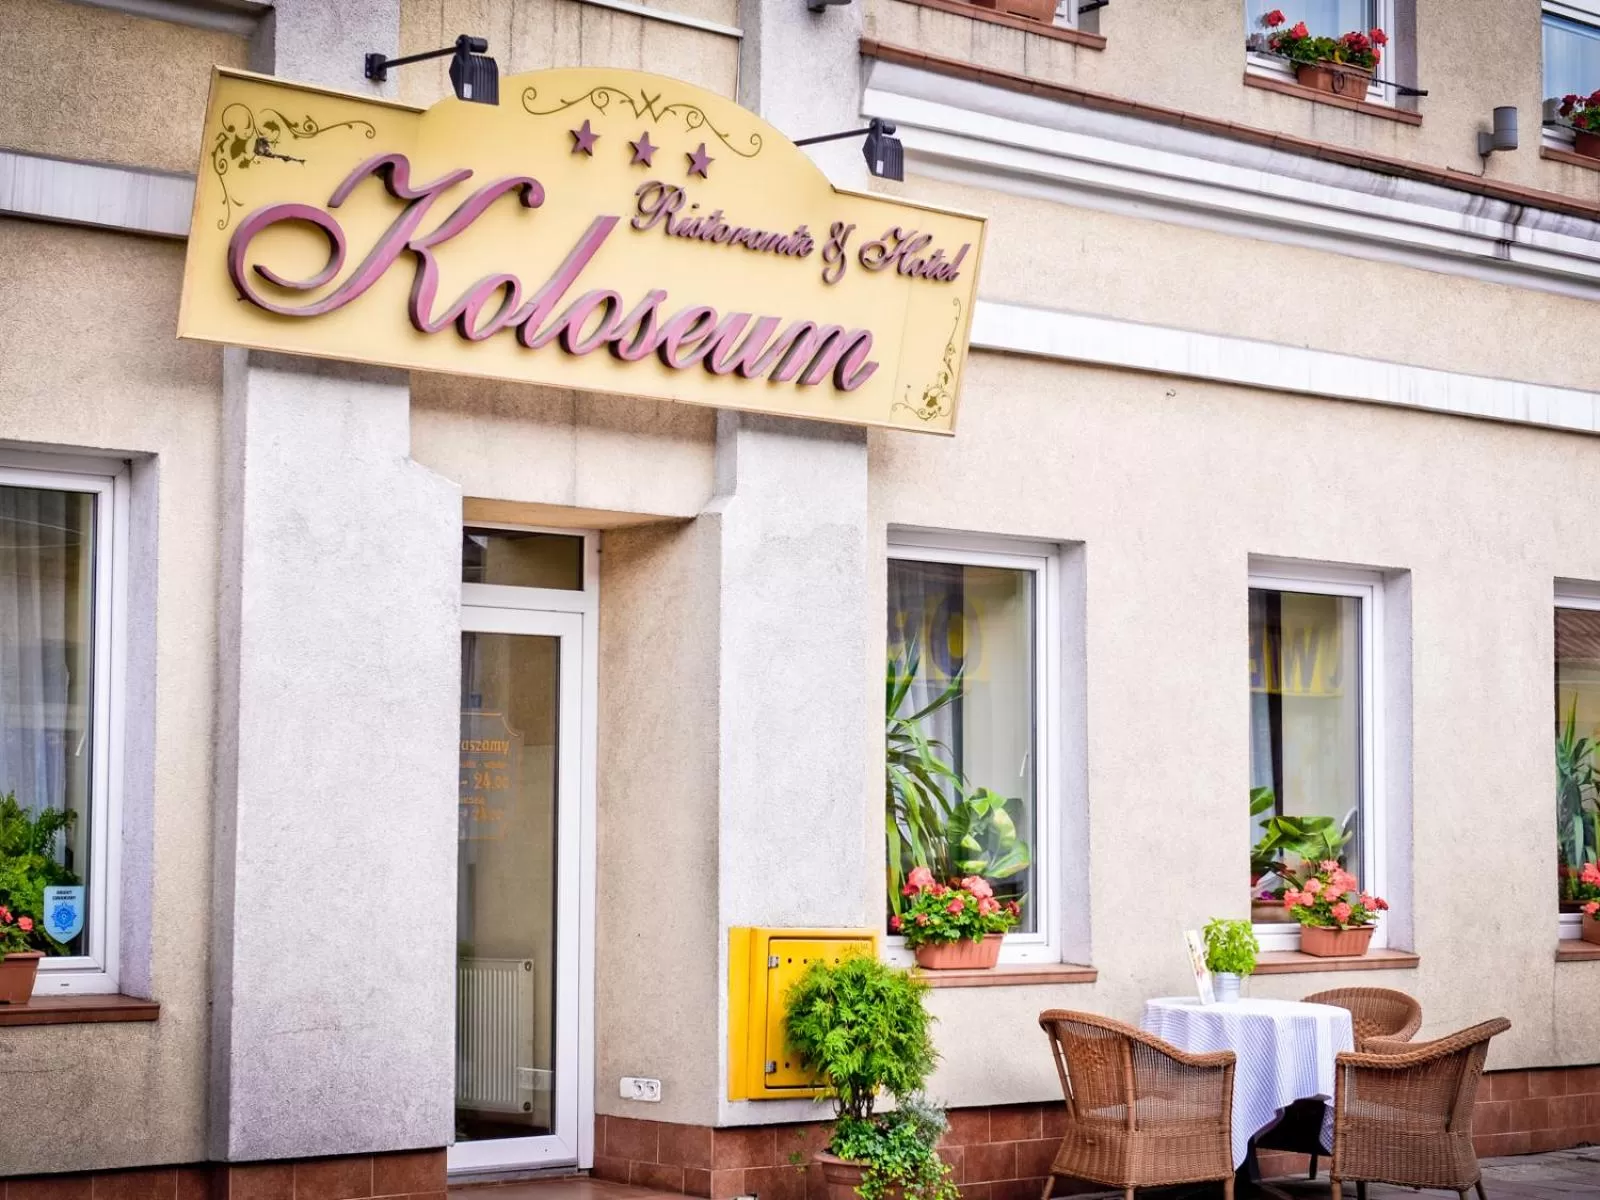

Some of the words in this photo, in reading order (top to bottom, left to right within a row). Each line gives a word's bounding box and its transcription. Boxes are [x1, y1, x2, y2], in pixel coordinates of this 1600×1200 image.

[228, 153, 880, 393] Koloseum
[631, 180, 815, 259] Ristorante
[859, 226, 972, 283] Hotel
